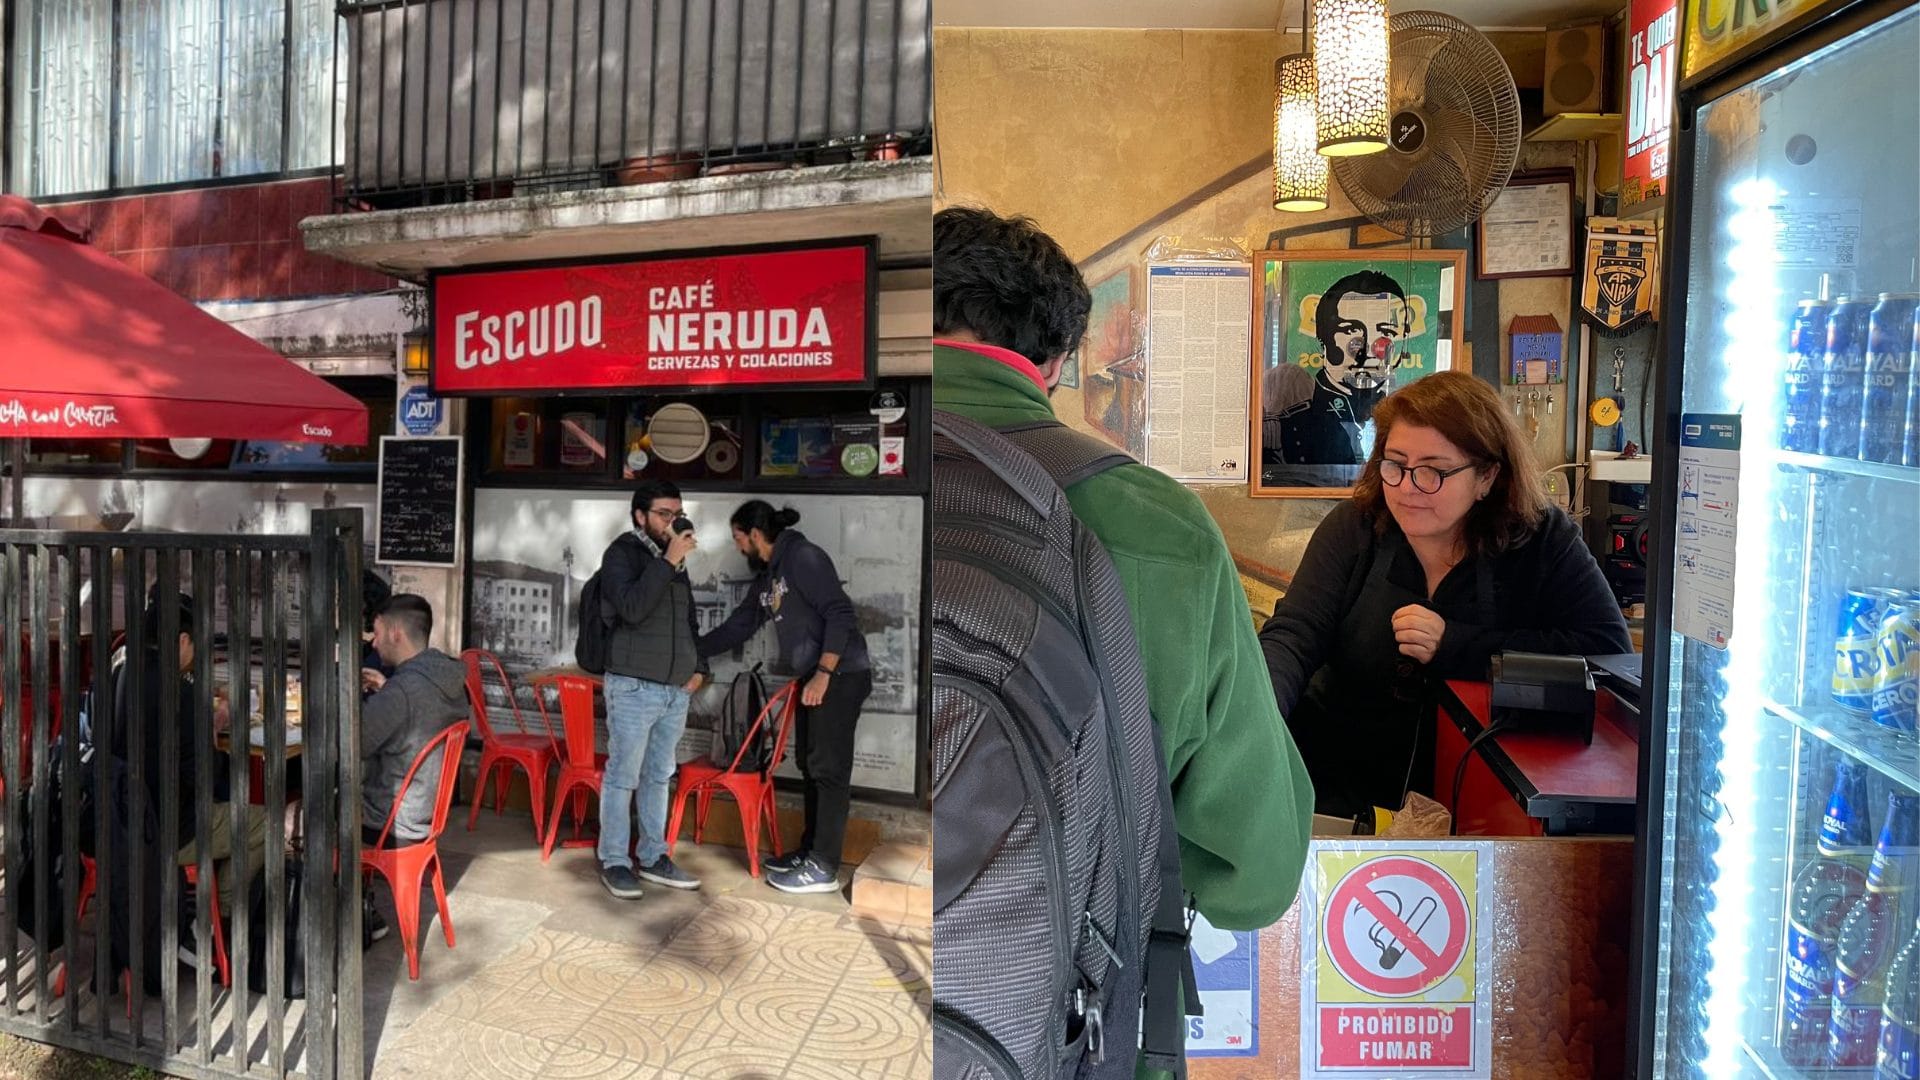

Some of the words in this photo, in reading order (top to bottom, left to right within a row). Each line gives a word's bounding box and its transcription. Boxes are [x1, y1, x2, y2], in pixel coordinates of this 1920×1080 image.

[1632, 31, 1643, 66] TE
[650, 279, 714, 311] CAFÉ
[648, 307, 832, 352] NERUDA
[648, 354, 720, 371] CERVEZAS
[725, 355, 735, 369] Y
[740, 352, 832, 369] COLACIONES
[406, 401, 436, 419] ADT
[302, 423, 332, 437] Escudo
[1185, 1017, 1204, 1040] S
[1337, 1015, 1454, 1036] PROHIBIDO
[1359, 1040, 1432, 1060] FUMAR
